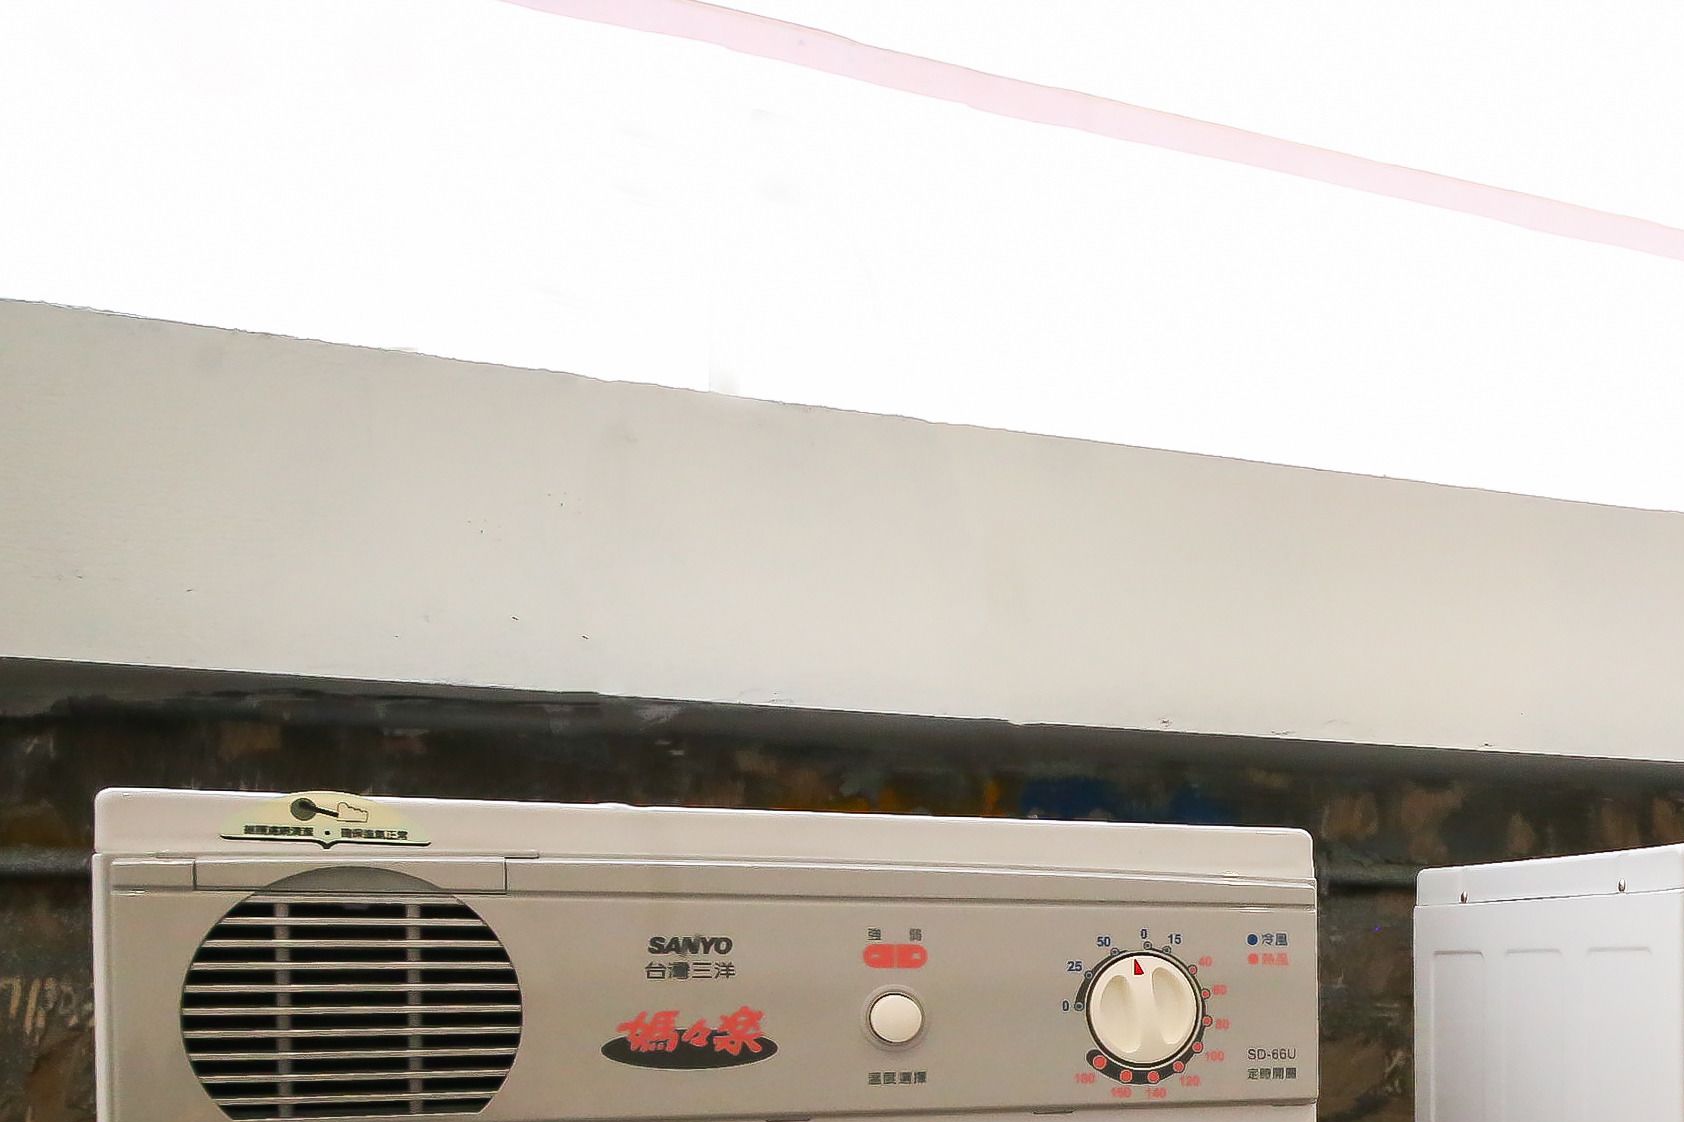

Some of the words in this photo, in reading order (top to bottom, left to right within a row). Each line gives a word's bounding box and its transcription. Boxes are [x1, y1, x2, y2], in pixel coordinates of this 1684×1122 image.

[1140, 929, 1148, 940] 0
[1168, 934, 1183, 945] 15
[648, 936, 733, 955] SANYO
[1096, 936, 1111, 947] 50
[645, 961, 736, 980] 台灣三洋
[1067, 961, 1082, 972] 25
[1062, 1001, 1070, 1011] 0
[1248, 1048, 1296, 1060] SD-66U
